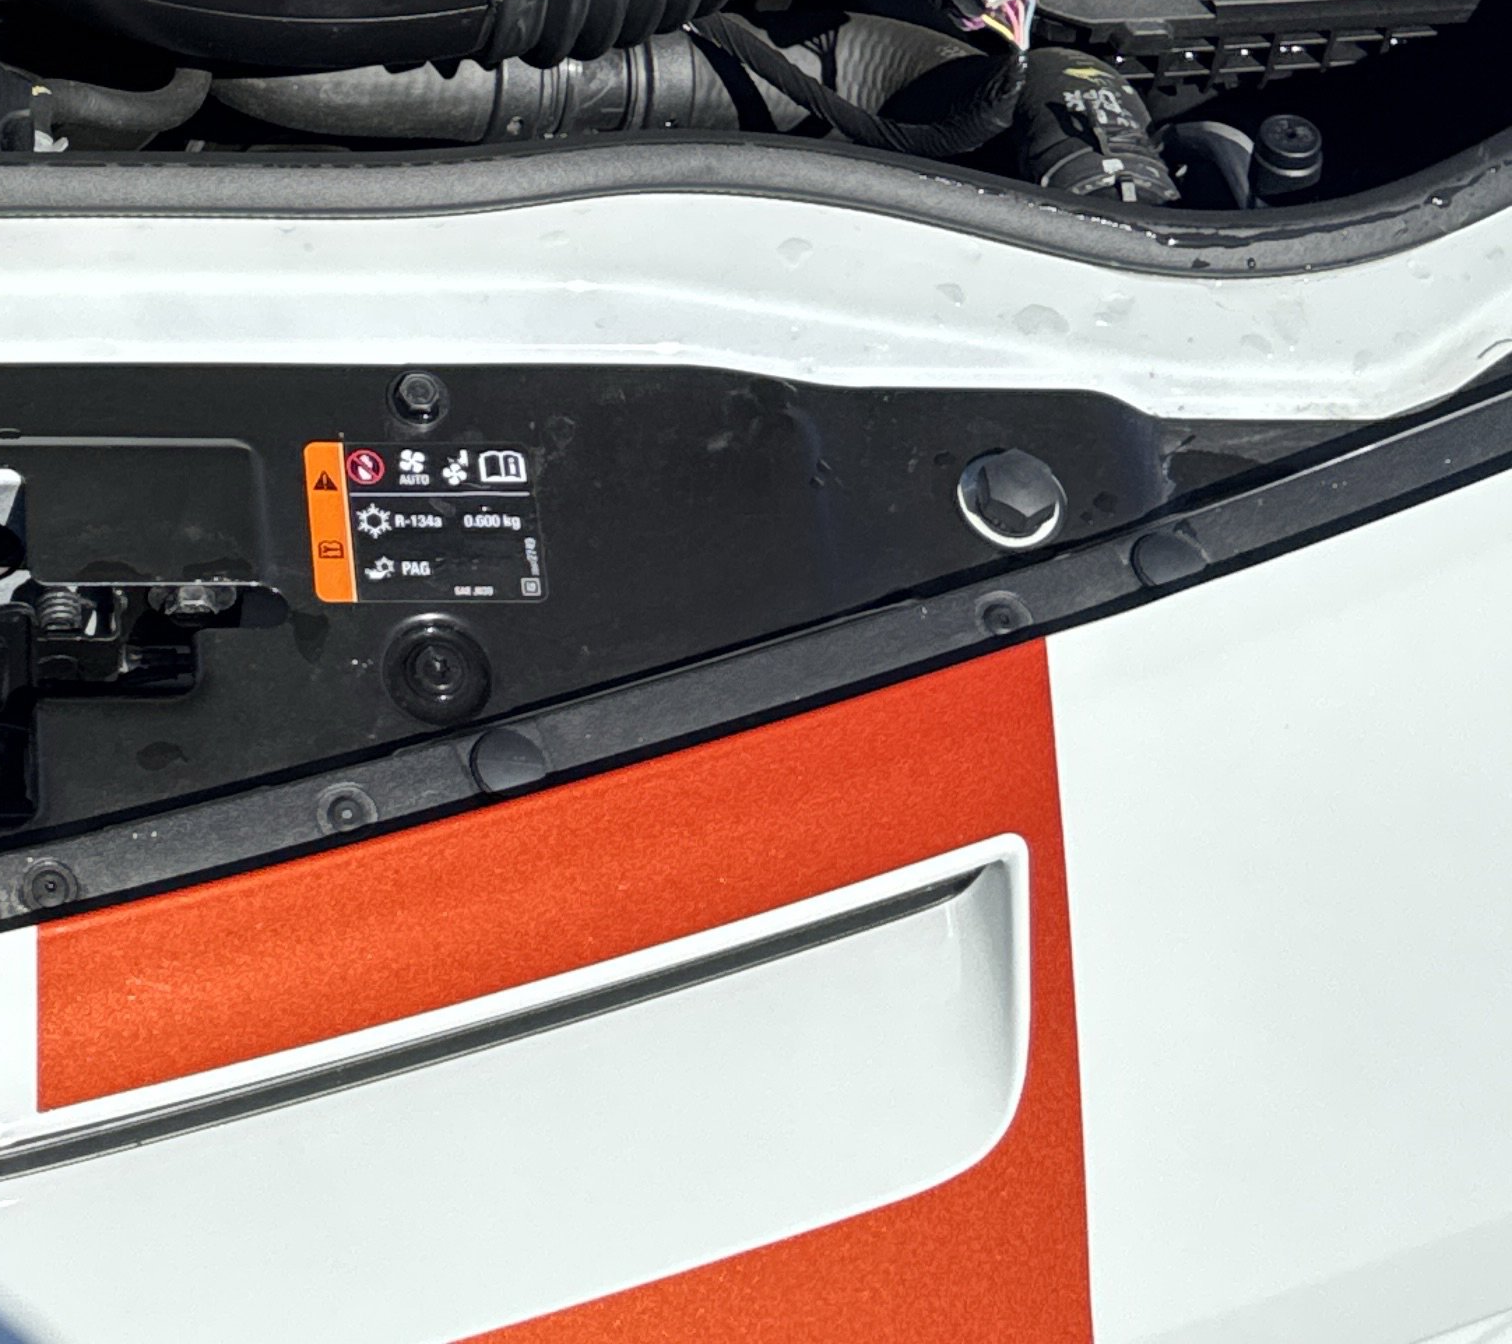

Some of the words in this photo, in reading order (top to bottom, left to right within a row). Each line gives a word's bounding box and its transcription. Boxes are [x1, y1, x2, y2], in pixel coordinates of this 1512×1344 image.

[399, 473, 430, 485] AUTO
[394, 514, 443, 528] R-134a
[502, 514, 522, 531] kg
[401, 560, 431, 576] PAG
